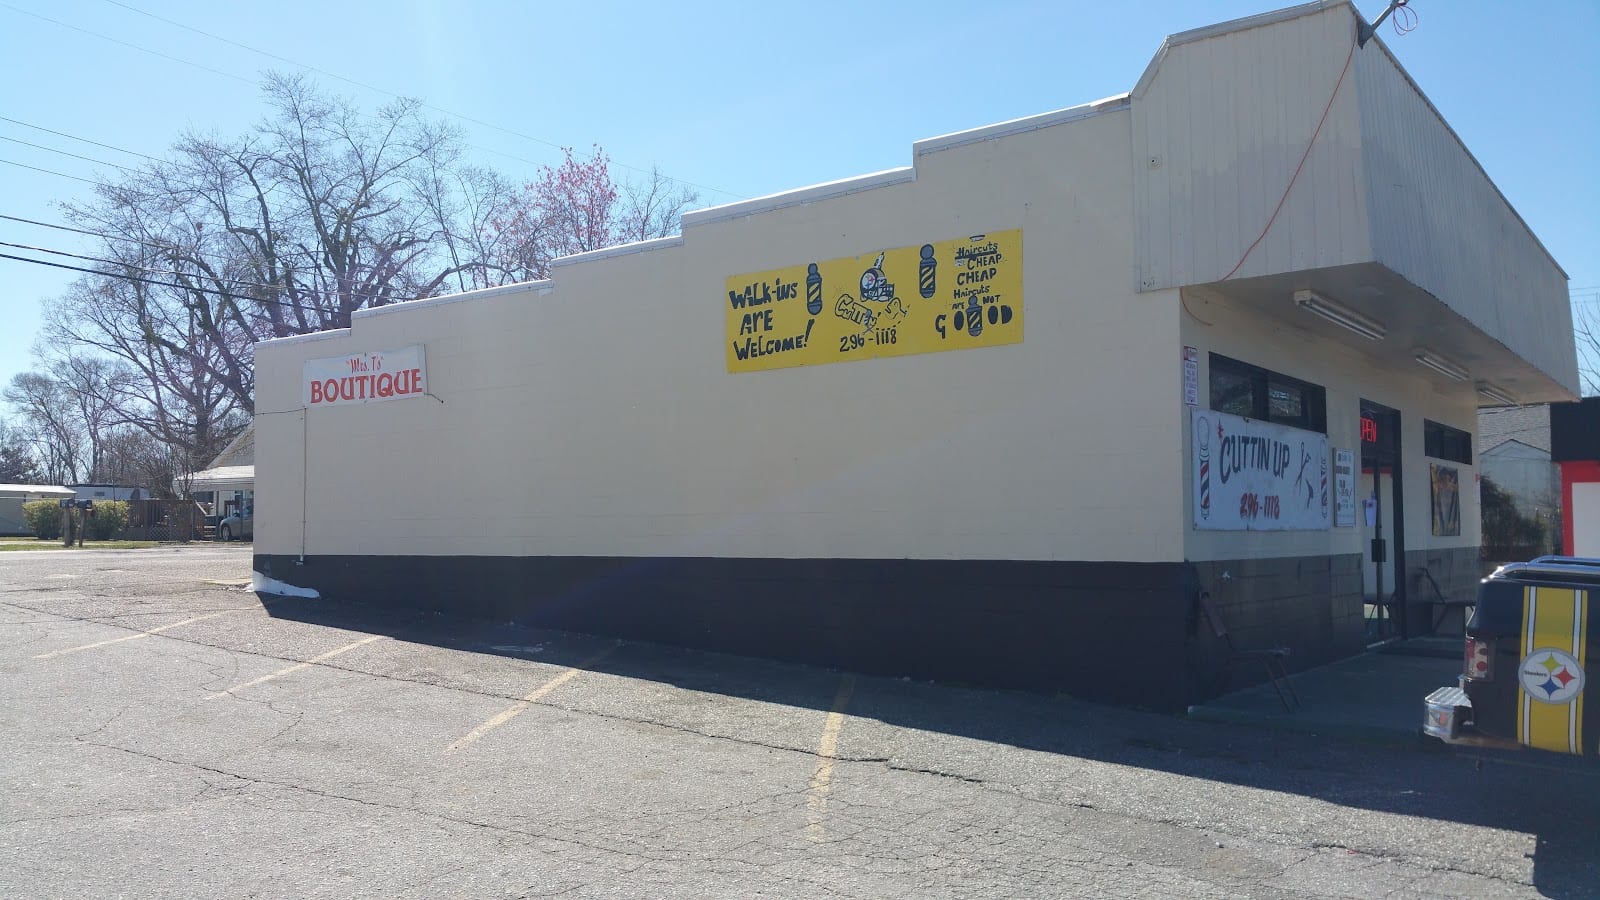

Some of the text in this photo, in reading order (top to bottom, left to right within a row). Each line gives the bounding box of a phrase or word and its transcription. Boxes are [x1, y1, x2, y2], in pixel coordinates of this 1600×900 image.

[967, 254, 1002, 270] CHEAP
[957, 268, 996, 285] CHEAP
[953, 285, 990, 299] Haircuts
[983, 295, 1000, 304] NOT
[733, 319, 815, 360] WELCOME!
[840, 328, 896, 352] 296-1118
[310, 368, 422, 403] BOUTIQUE
[1219, 434, 1290, 484] CUTTIN UP
[1240, 492, 1280, 520] 296-1118
